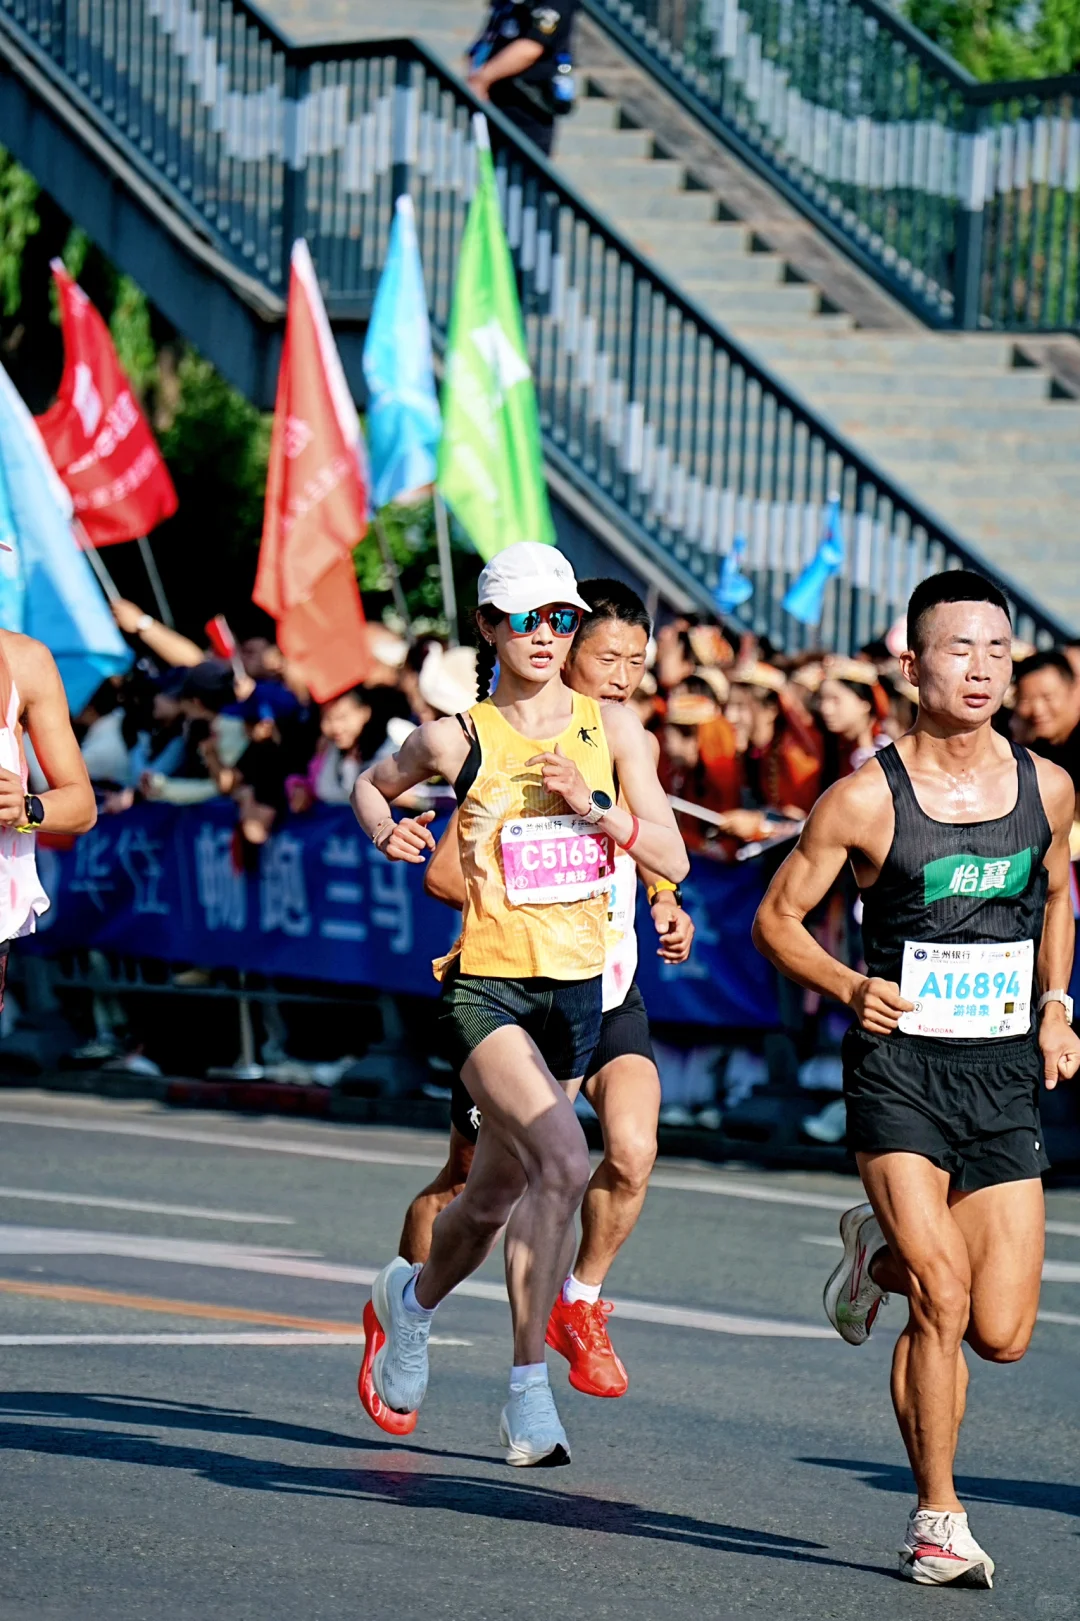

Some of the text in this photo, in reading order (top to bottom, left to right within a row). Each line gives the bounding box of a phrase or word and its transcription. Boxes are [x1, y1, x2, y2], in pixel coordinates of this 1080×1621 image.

[526, 820, 563, 831] 兰州银行
[521, 836, 608, 871] C51653
[949, 860, 1011, 893] 怡寶
[930, 949, 971, 959] 兰州银行
[918, 970, 1020, 1000] A16894
